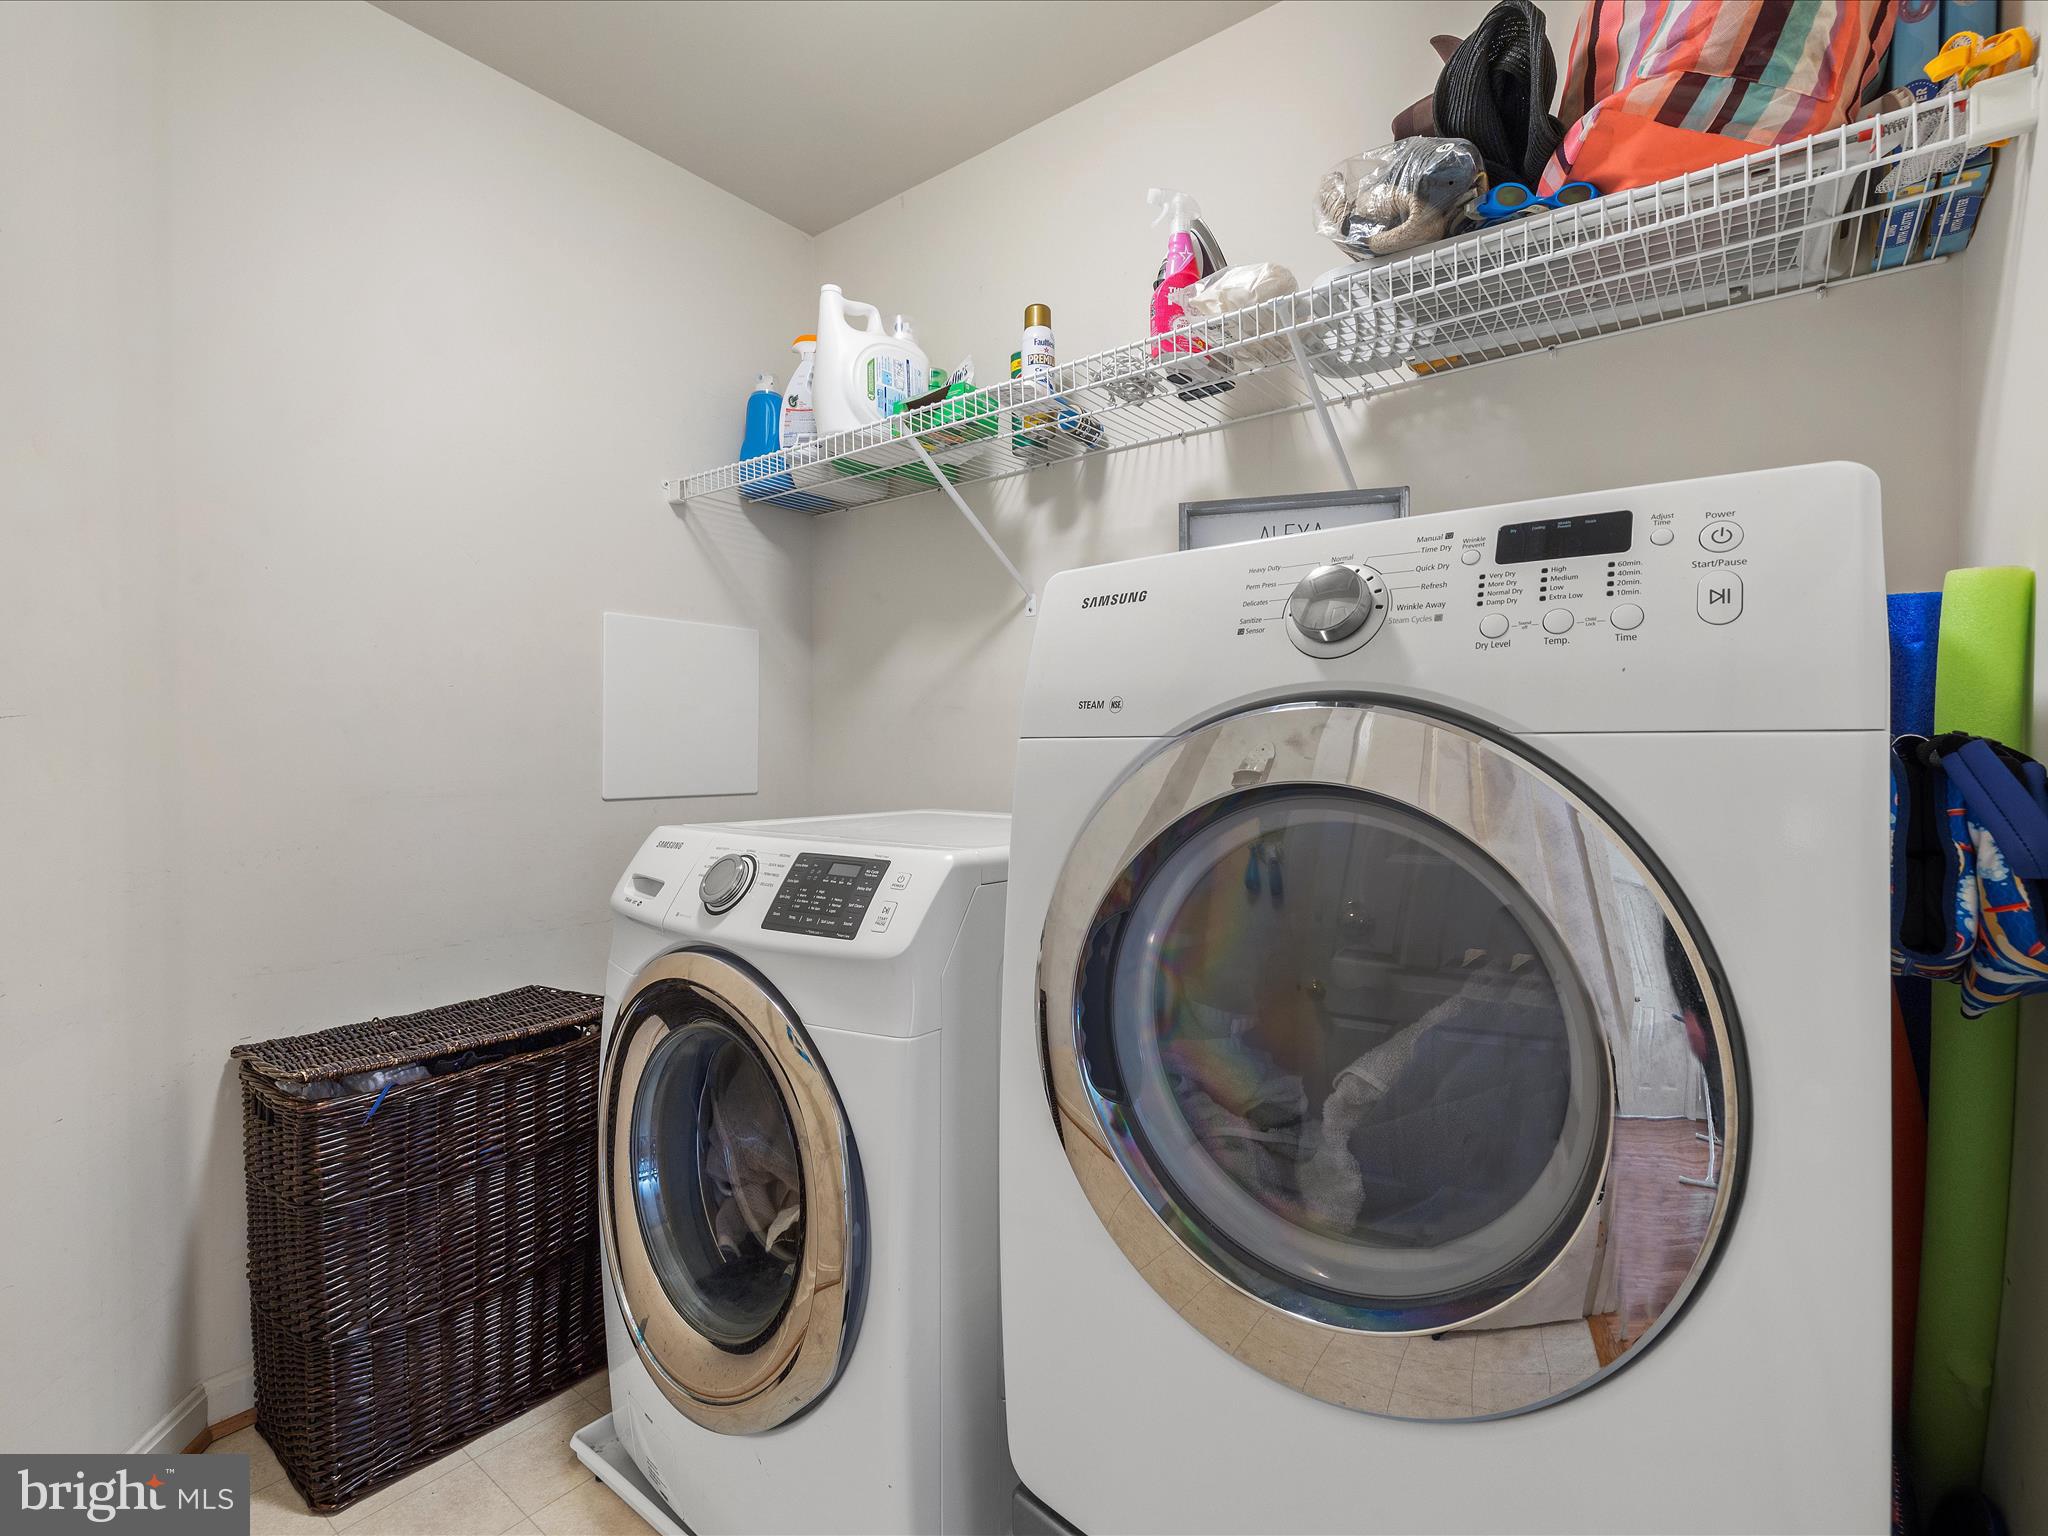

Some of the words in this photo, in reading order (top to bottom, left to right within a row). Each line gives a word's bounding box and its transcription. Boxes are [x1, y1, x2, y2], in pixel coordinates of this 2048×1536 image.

[1028, 353, 1055, 367] PREMI
[1651, 513, 1675, 521] Adjust
[1705, 510, 1736, 519] Power
[1416, 534, 1444, 543] Manual
[1462, 536, 1486, 544] Wrinkle
[1440, 544, 1452, 552] Dry
[1331, 554, 1354, 563] Normal
[1692, 558, 1748, 569] Start/Pause
[1416, 564, 1435, 573] Quick
[1551, 565, 1567, 573] High
[1617, 569, 1643, 577] 40min.
[1420, 581, 1448, 590] Refresh
[1487, 589, 1511, 597] Normal
[1617, 588, 1642, 596] 10min.
[1081, 590, 1148, 609] SAMSUNG
[1242, 600, 1269, 608] Delicates
[1396, 602, 1424, 611] Wrinkle
[1425, 601, 1446, 609] Away
[1240, 616, 1262, 625] Sanitize
[1388, 616, 1410, 624] Steam
[1411, 615, 1433, 624] Cycles
[1544, 637, 1570, 646] Temp.
[1615, 633, 1638, 641] Time
[1475, 641, 1489, 651] Dry
[1490, 639, 1511, 649] Level
[1078, 700, 1105, 710] STEAM
[656, 840, 684, 851] SAMSUNG
